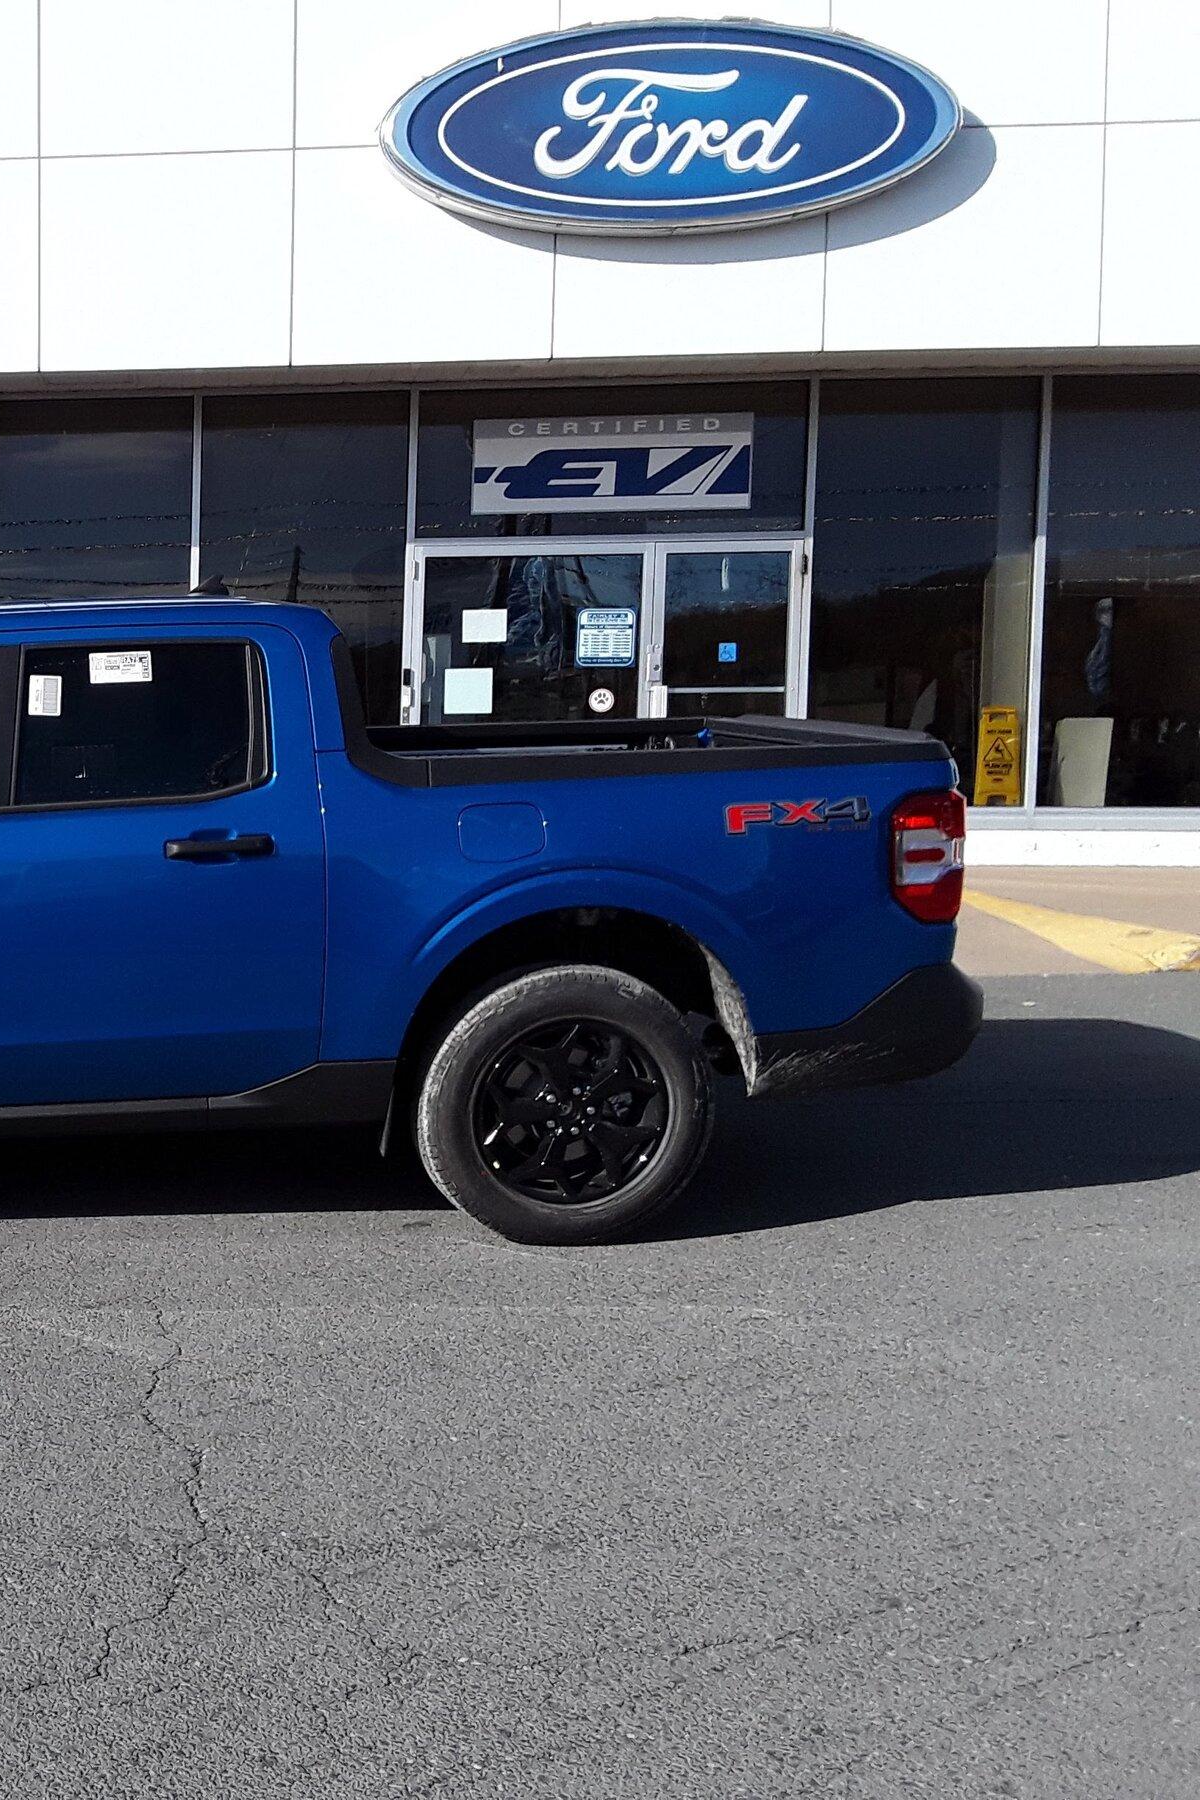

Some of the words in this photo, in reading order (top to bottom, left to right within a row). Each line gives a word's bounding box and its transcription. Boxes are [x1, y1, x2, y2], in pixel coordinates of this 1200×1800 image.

[533, 68, 809, 179] Ford
[507, 417, 722, 436] CERTIFIED
[725, 797, 871, 835] FX4
